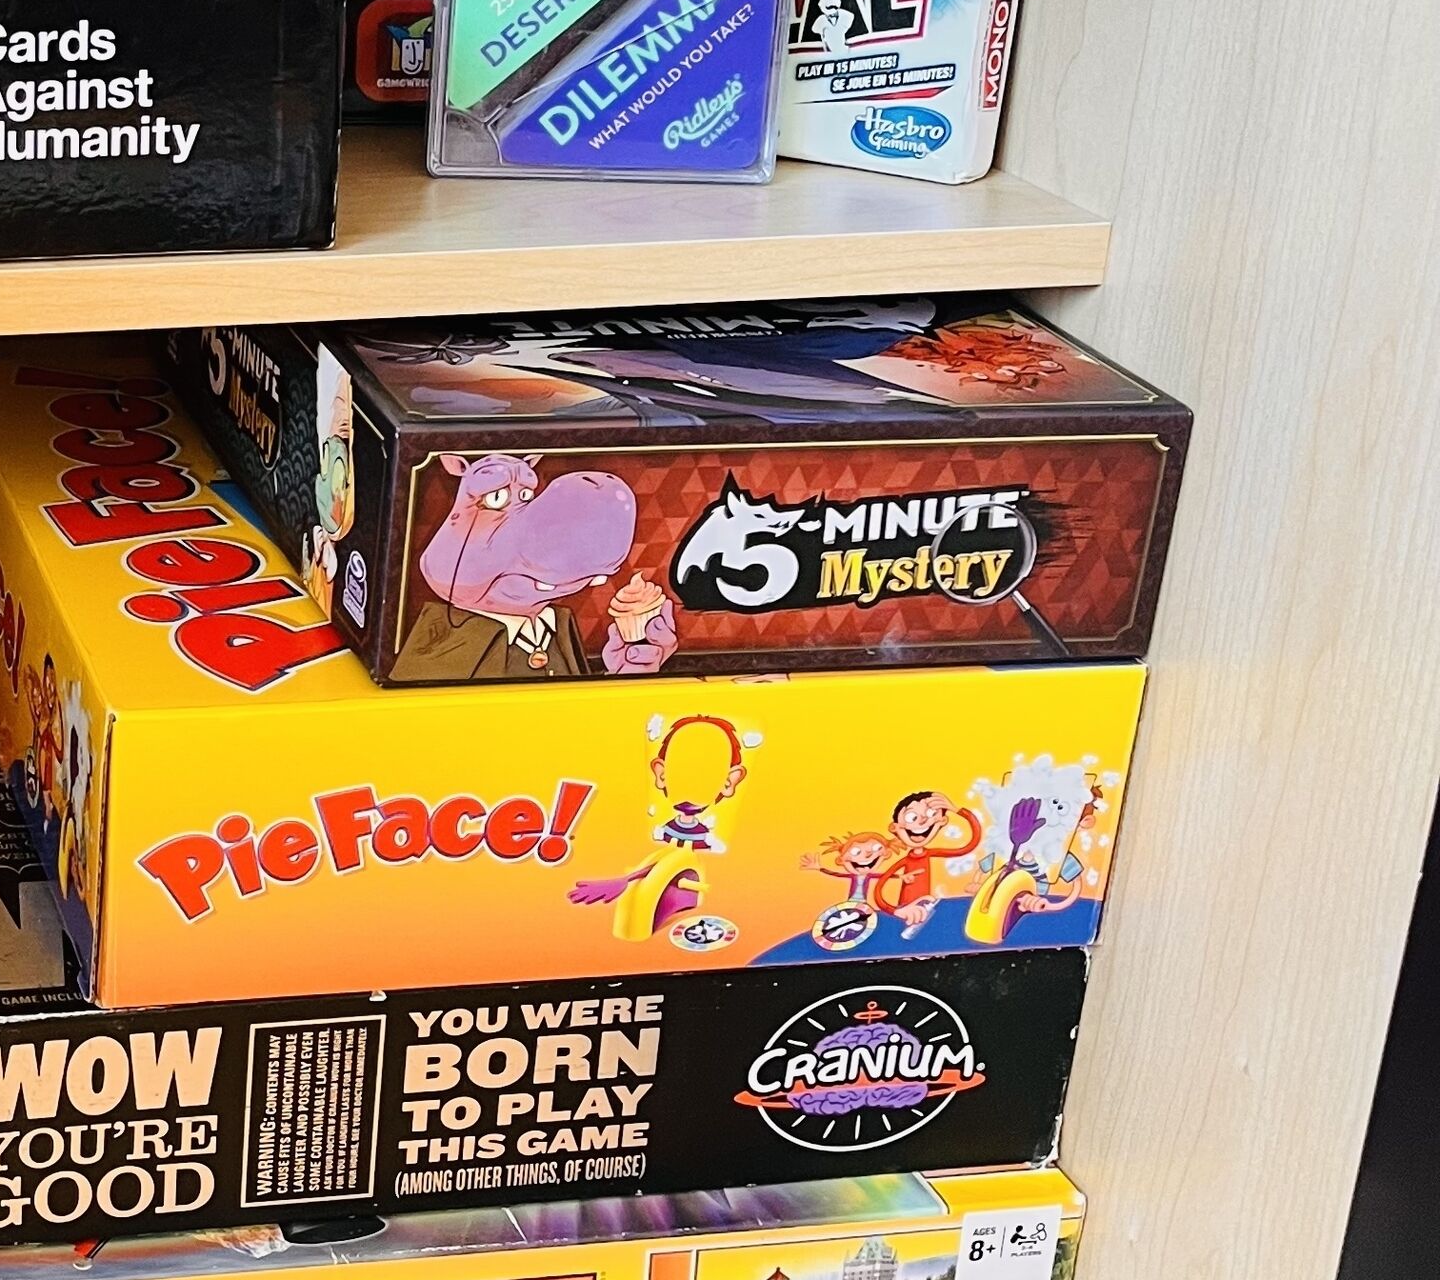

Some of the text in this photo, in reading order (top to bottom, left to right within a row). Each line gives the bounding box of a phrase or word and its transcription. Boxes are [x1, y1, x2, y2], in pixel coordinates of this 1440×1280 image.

[588, 3, 755, 150] WHAT WOULD YOU TAKE?
[837, 61, 849, 73] 15
[663, 78, 747, 149] Ridley's
[700, 113, 740, 148] GAMES
[855, 106, 945, 141] Hasbro
[868, 131, 931, 158] Gaming
[13, 366, 349, 694] Pie Face!
[817, 545, 1013, 605] Mystery
[136, 778, 597, 924] Pie Face!
[1, 994, 37, 1006] GAME
[409, 995, 663, 1037] YOU WERE
[403, 1026, 661, 1093] BORN
[257, 1035, 281, 1196] WARNING: CONTENTS MAY
[277, 1033, 298, 1194] CAUSE FITS OF UNCONTAINABLE
[293, 1031, 314, 1193] LAUGHTER AND POSSIBLY EVEN
[309, 1027, 330, 1191] SOME CONTAINABLE LAUGHTER.
[402, 1083, 652, 1133] TO PLAY
[398, 1122, 649, 1165] THIS GAME
[395, 1153, 647, 1199] (AMONG OTHER THINGS, OF COURSE)
[969, 1240, 996, 1262] 8+
[972, 1227, 996, 1236] AGES
